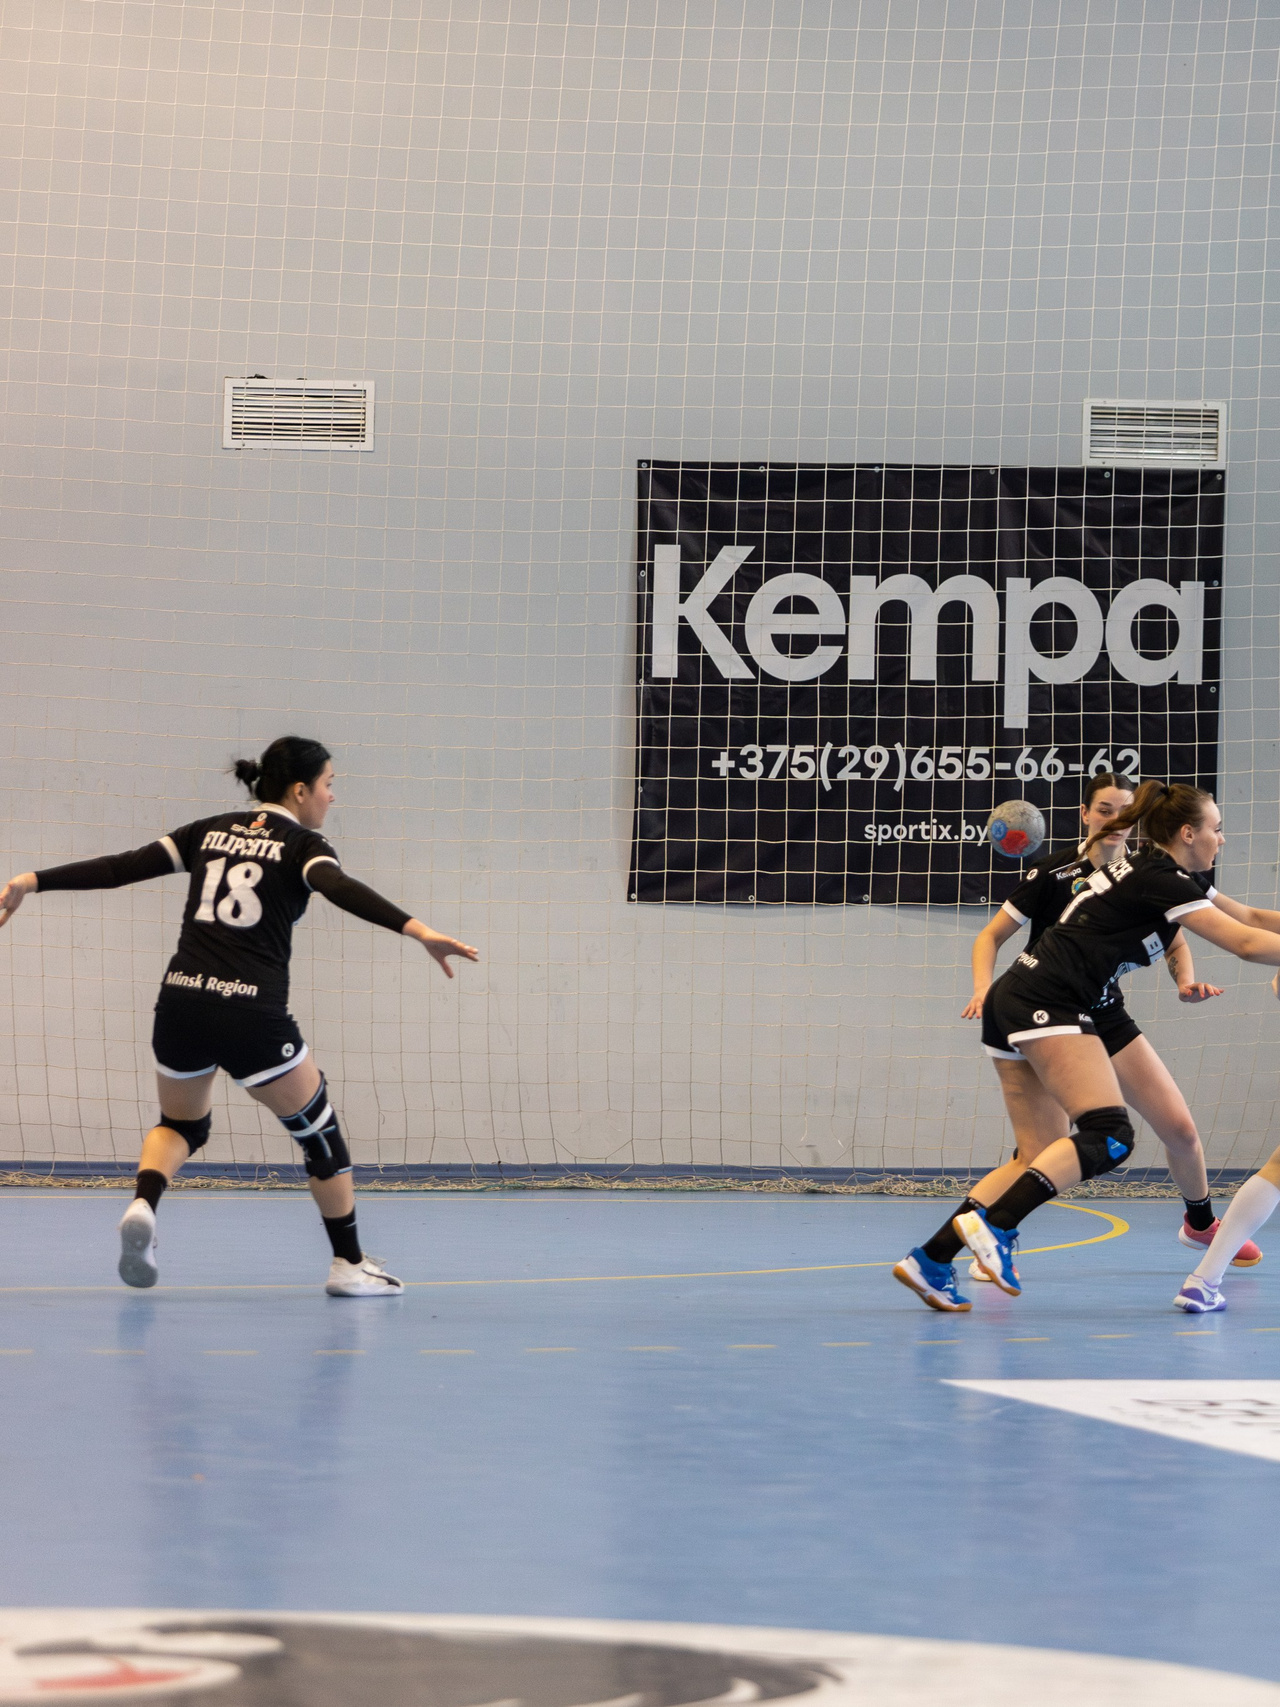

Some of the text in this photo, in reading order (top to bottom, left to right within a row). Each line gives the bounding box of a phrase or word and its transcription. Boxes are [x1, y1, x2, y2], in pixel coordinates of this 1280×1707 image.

[652, 544, 1205, 728] Kempa
[711, 741, 1140, 792] +375(29)655-66-62
[200, 831, 286, 862] FILIPCHYK
[864, 818, 988, 847] sportix.by
[194, 857, 264, 928] 18
[1059, 868, 1113, 924] 7
[164, 970, 259, 997] Minsk Region
